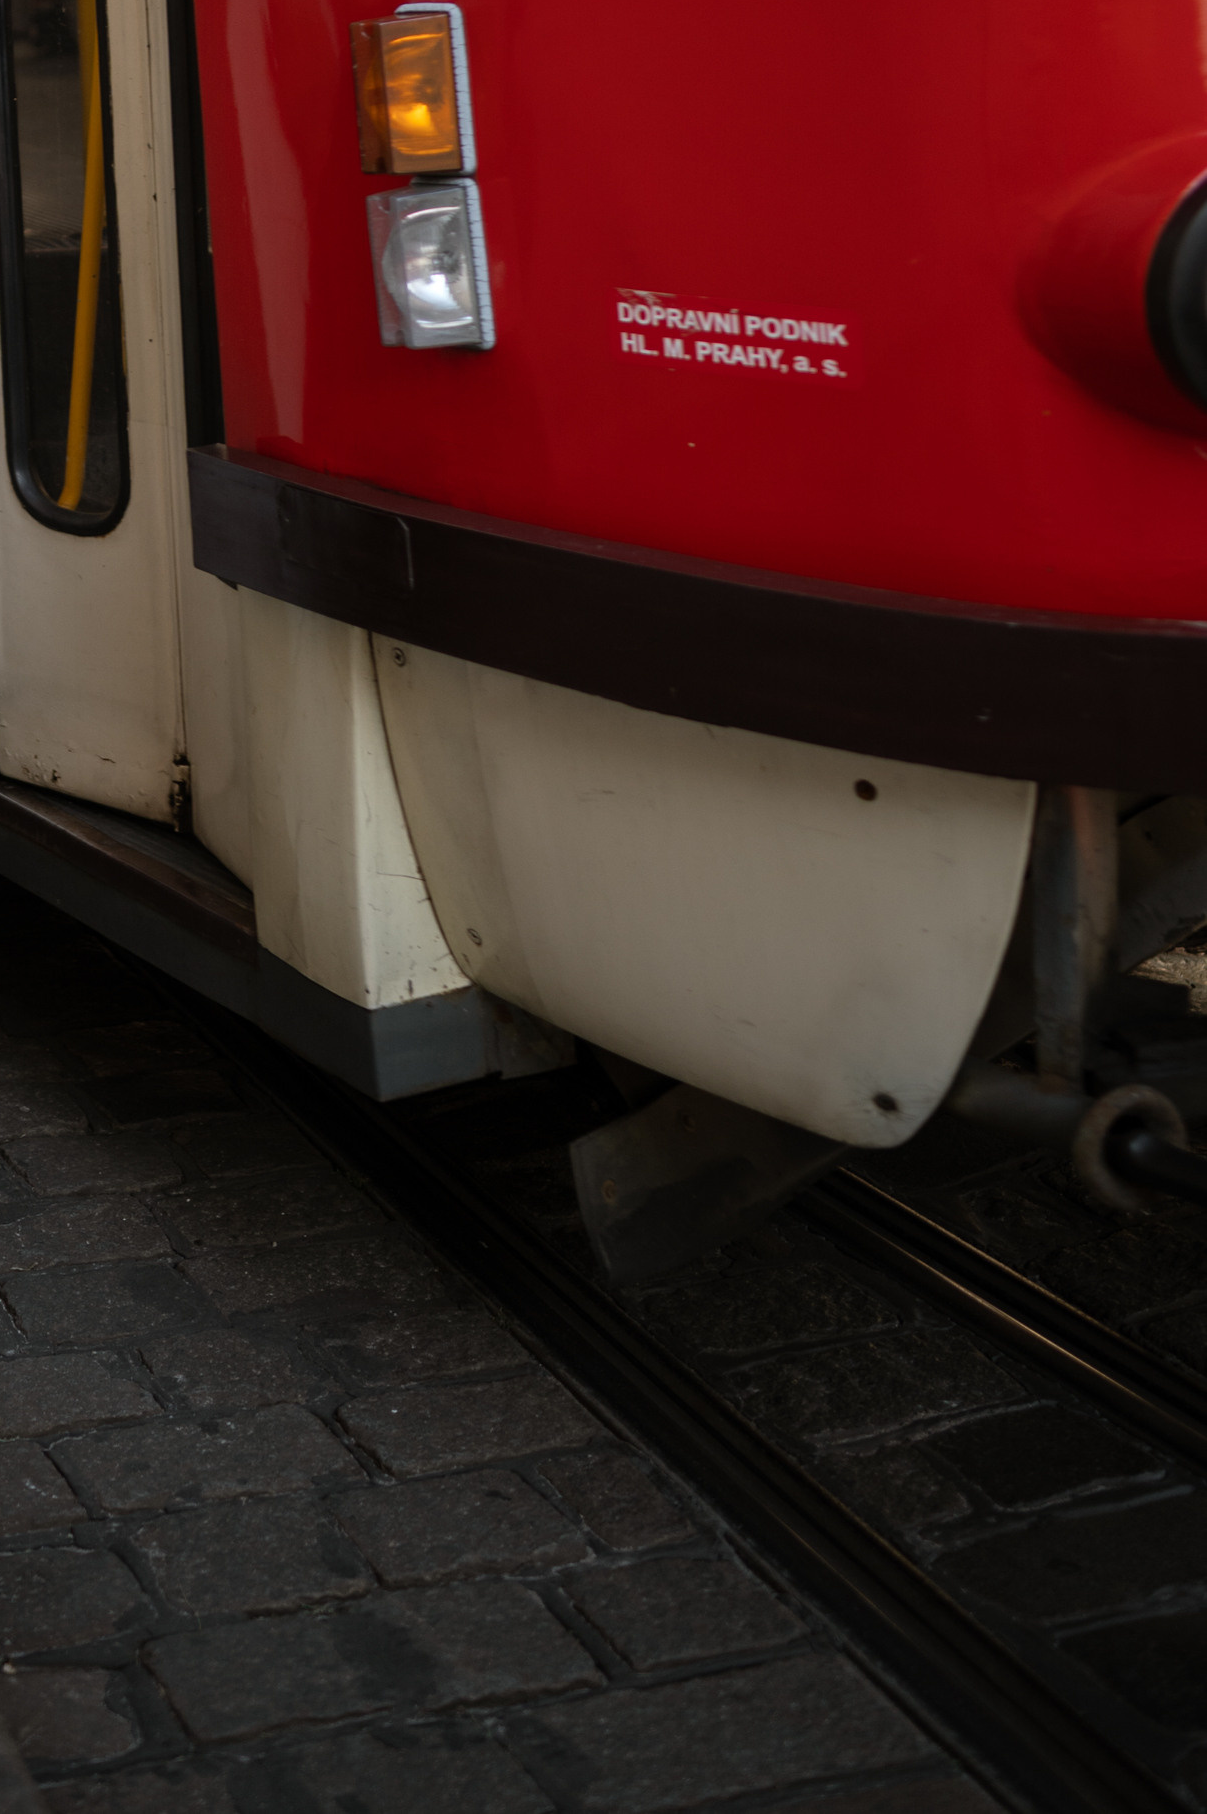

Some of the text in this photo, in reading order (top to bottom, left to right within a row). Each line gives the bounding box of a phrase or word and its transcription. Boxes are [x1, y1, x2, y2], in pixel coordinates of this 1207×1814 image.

[617, 302, 849, 346] DOPRAVNÍ PODNIK
[621, 331, 848, 378] HL. M. PRAHY, a. s.
